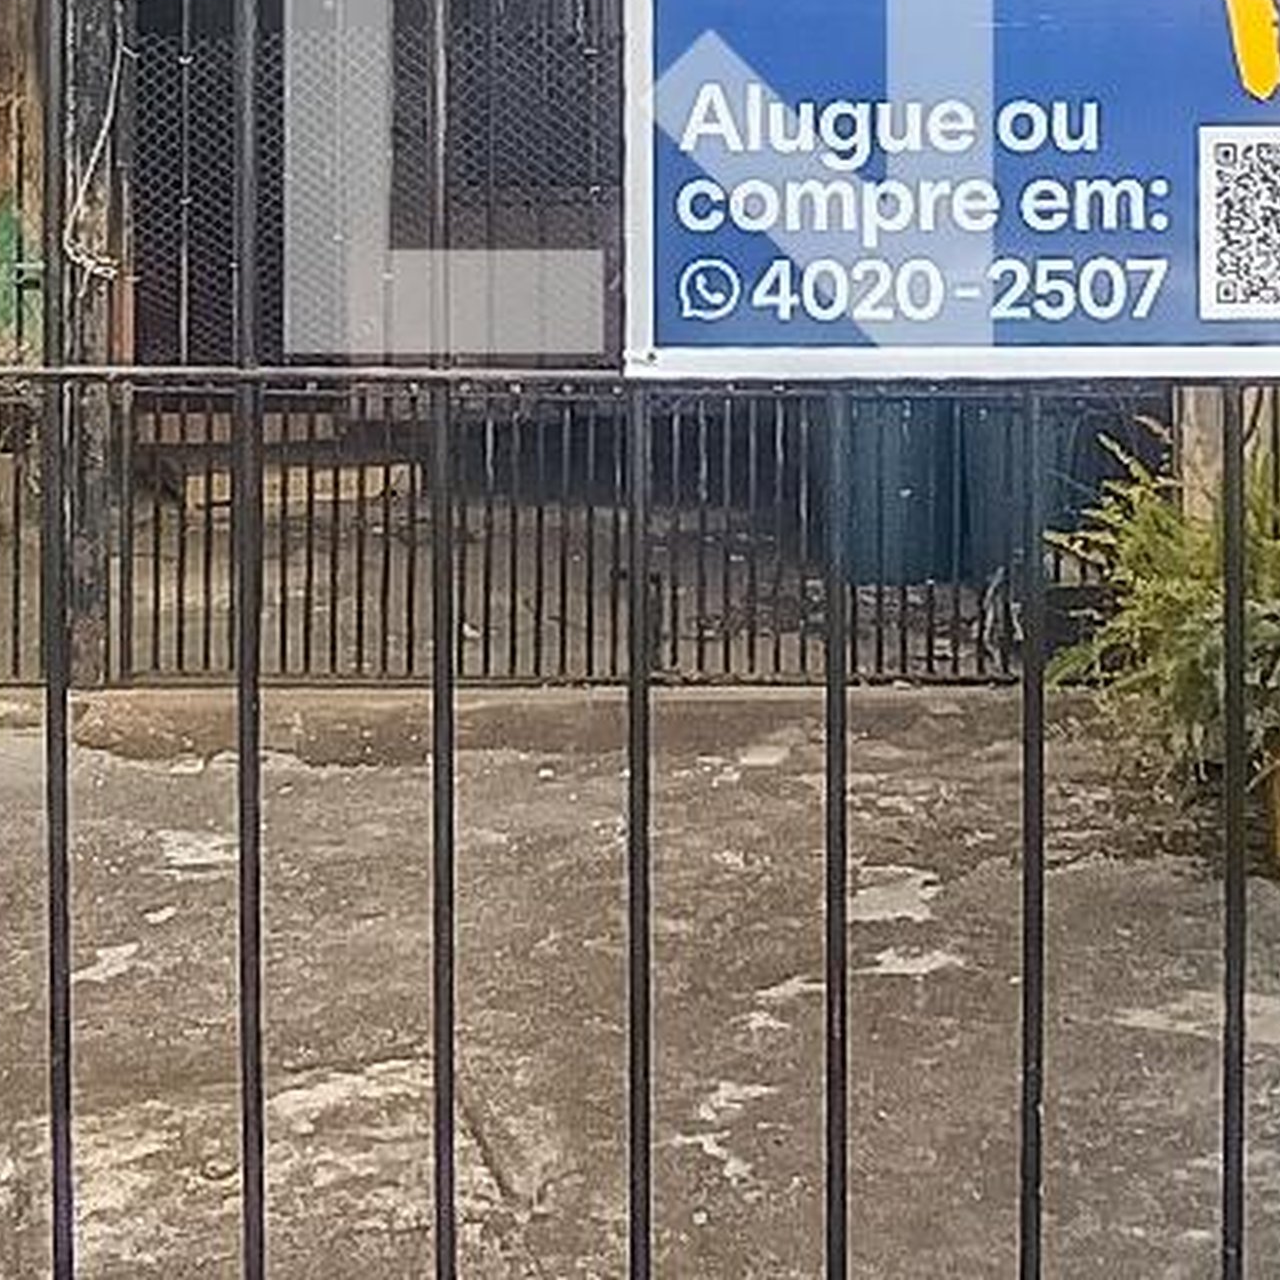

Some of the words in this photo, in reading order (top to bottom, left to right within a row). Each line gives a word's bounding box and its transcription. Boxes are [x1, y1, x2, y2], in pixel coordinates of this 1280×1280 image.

[678, 83, 976, 169] Alugue
[997, 99, 1099, 151] ou
[676, 177, 1000, 245] compre
[1020, 177, 1171, 231] em:
